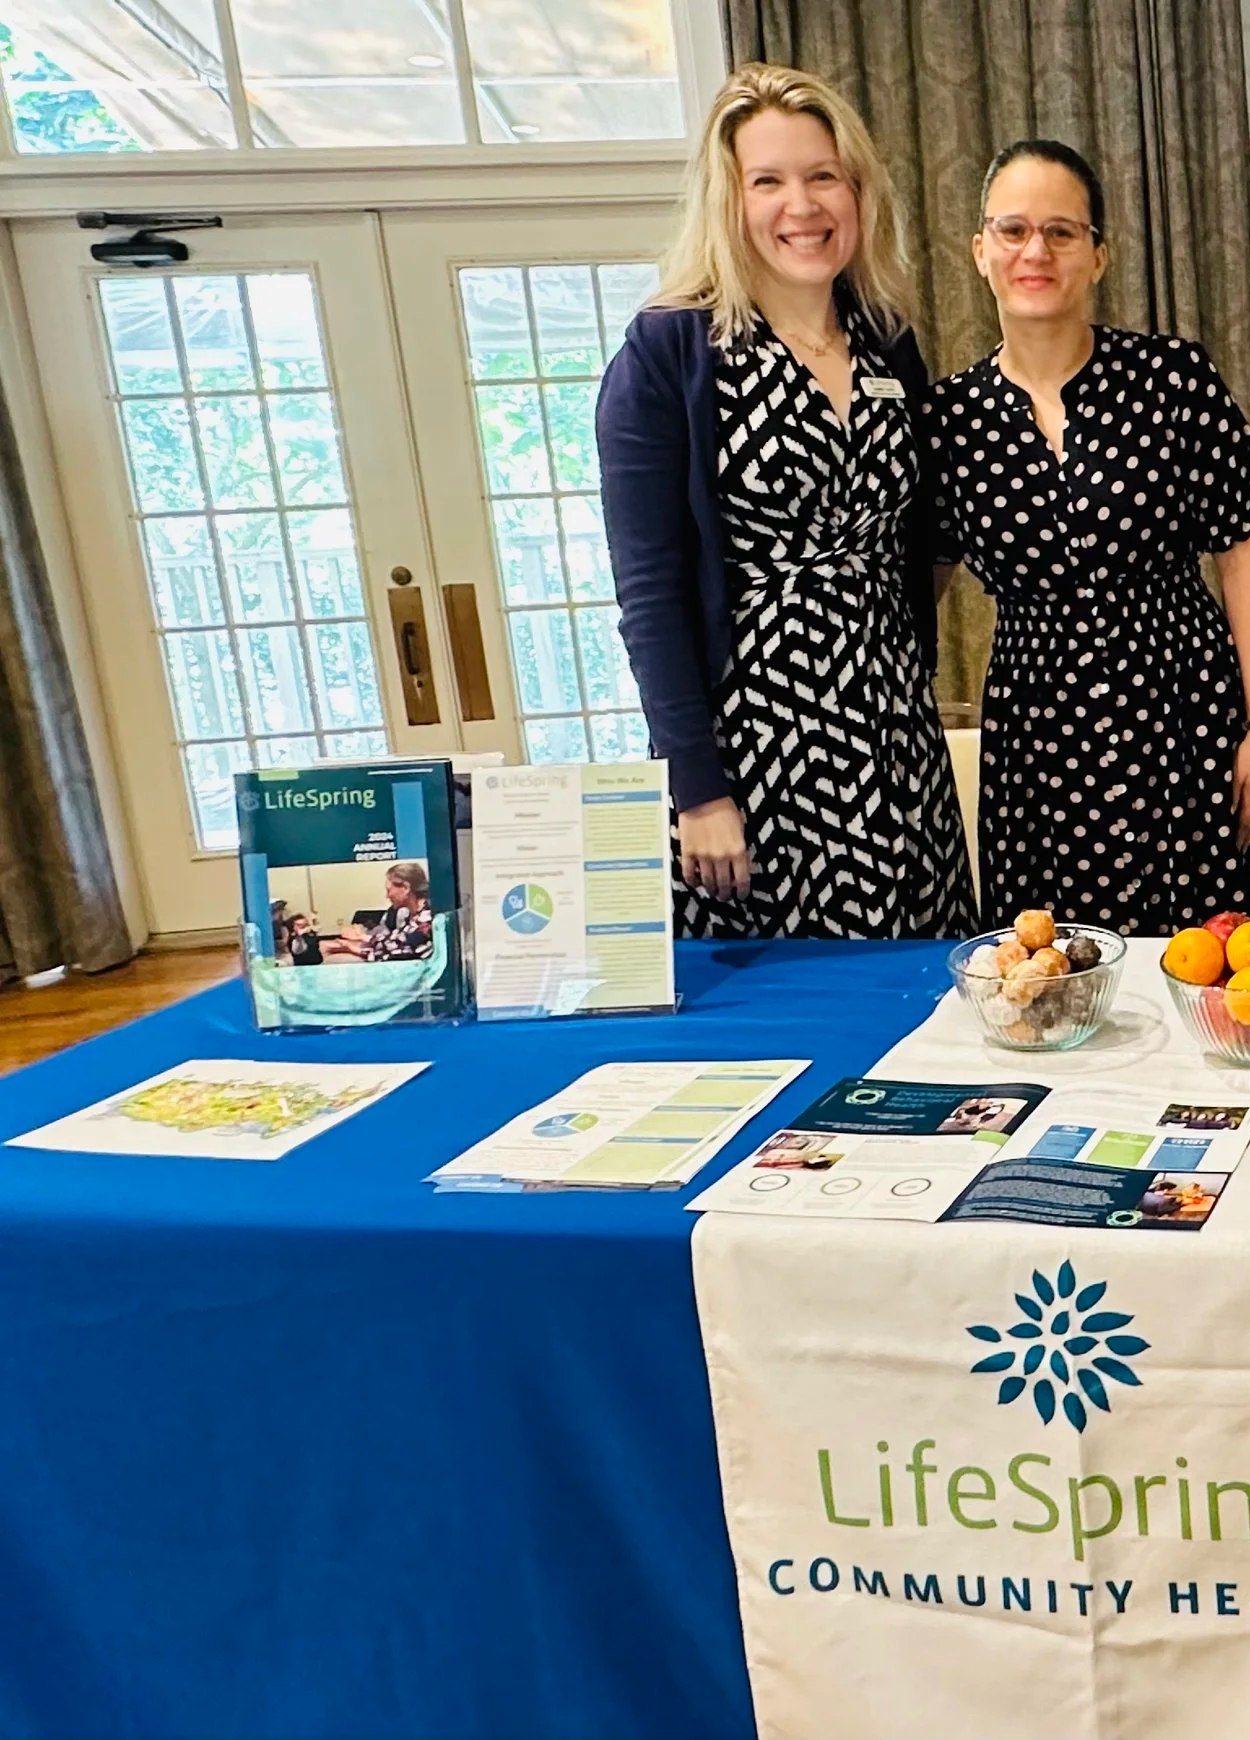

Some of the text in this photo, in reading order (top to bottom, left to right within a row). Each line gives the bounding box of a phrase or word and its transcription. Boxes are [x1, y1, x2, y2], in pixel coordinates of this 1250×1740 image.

[502, 775, 568, 790] LifeSpring
[264, 787, 376, 810] LifeSpring
[353, 842, 397, 853] ANNUAL
[355, 851, 398, 862] REPORT
[767, 1556, 1134, 1617] COMMUNITY
